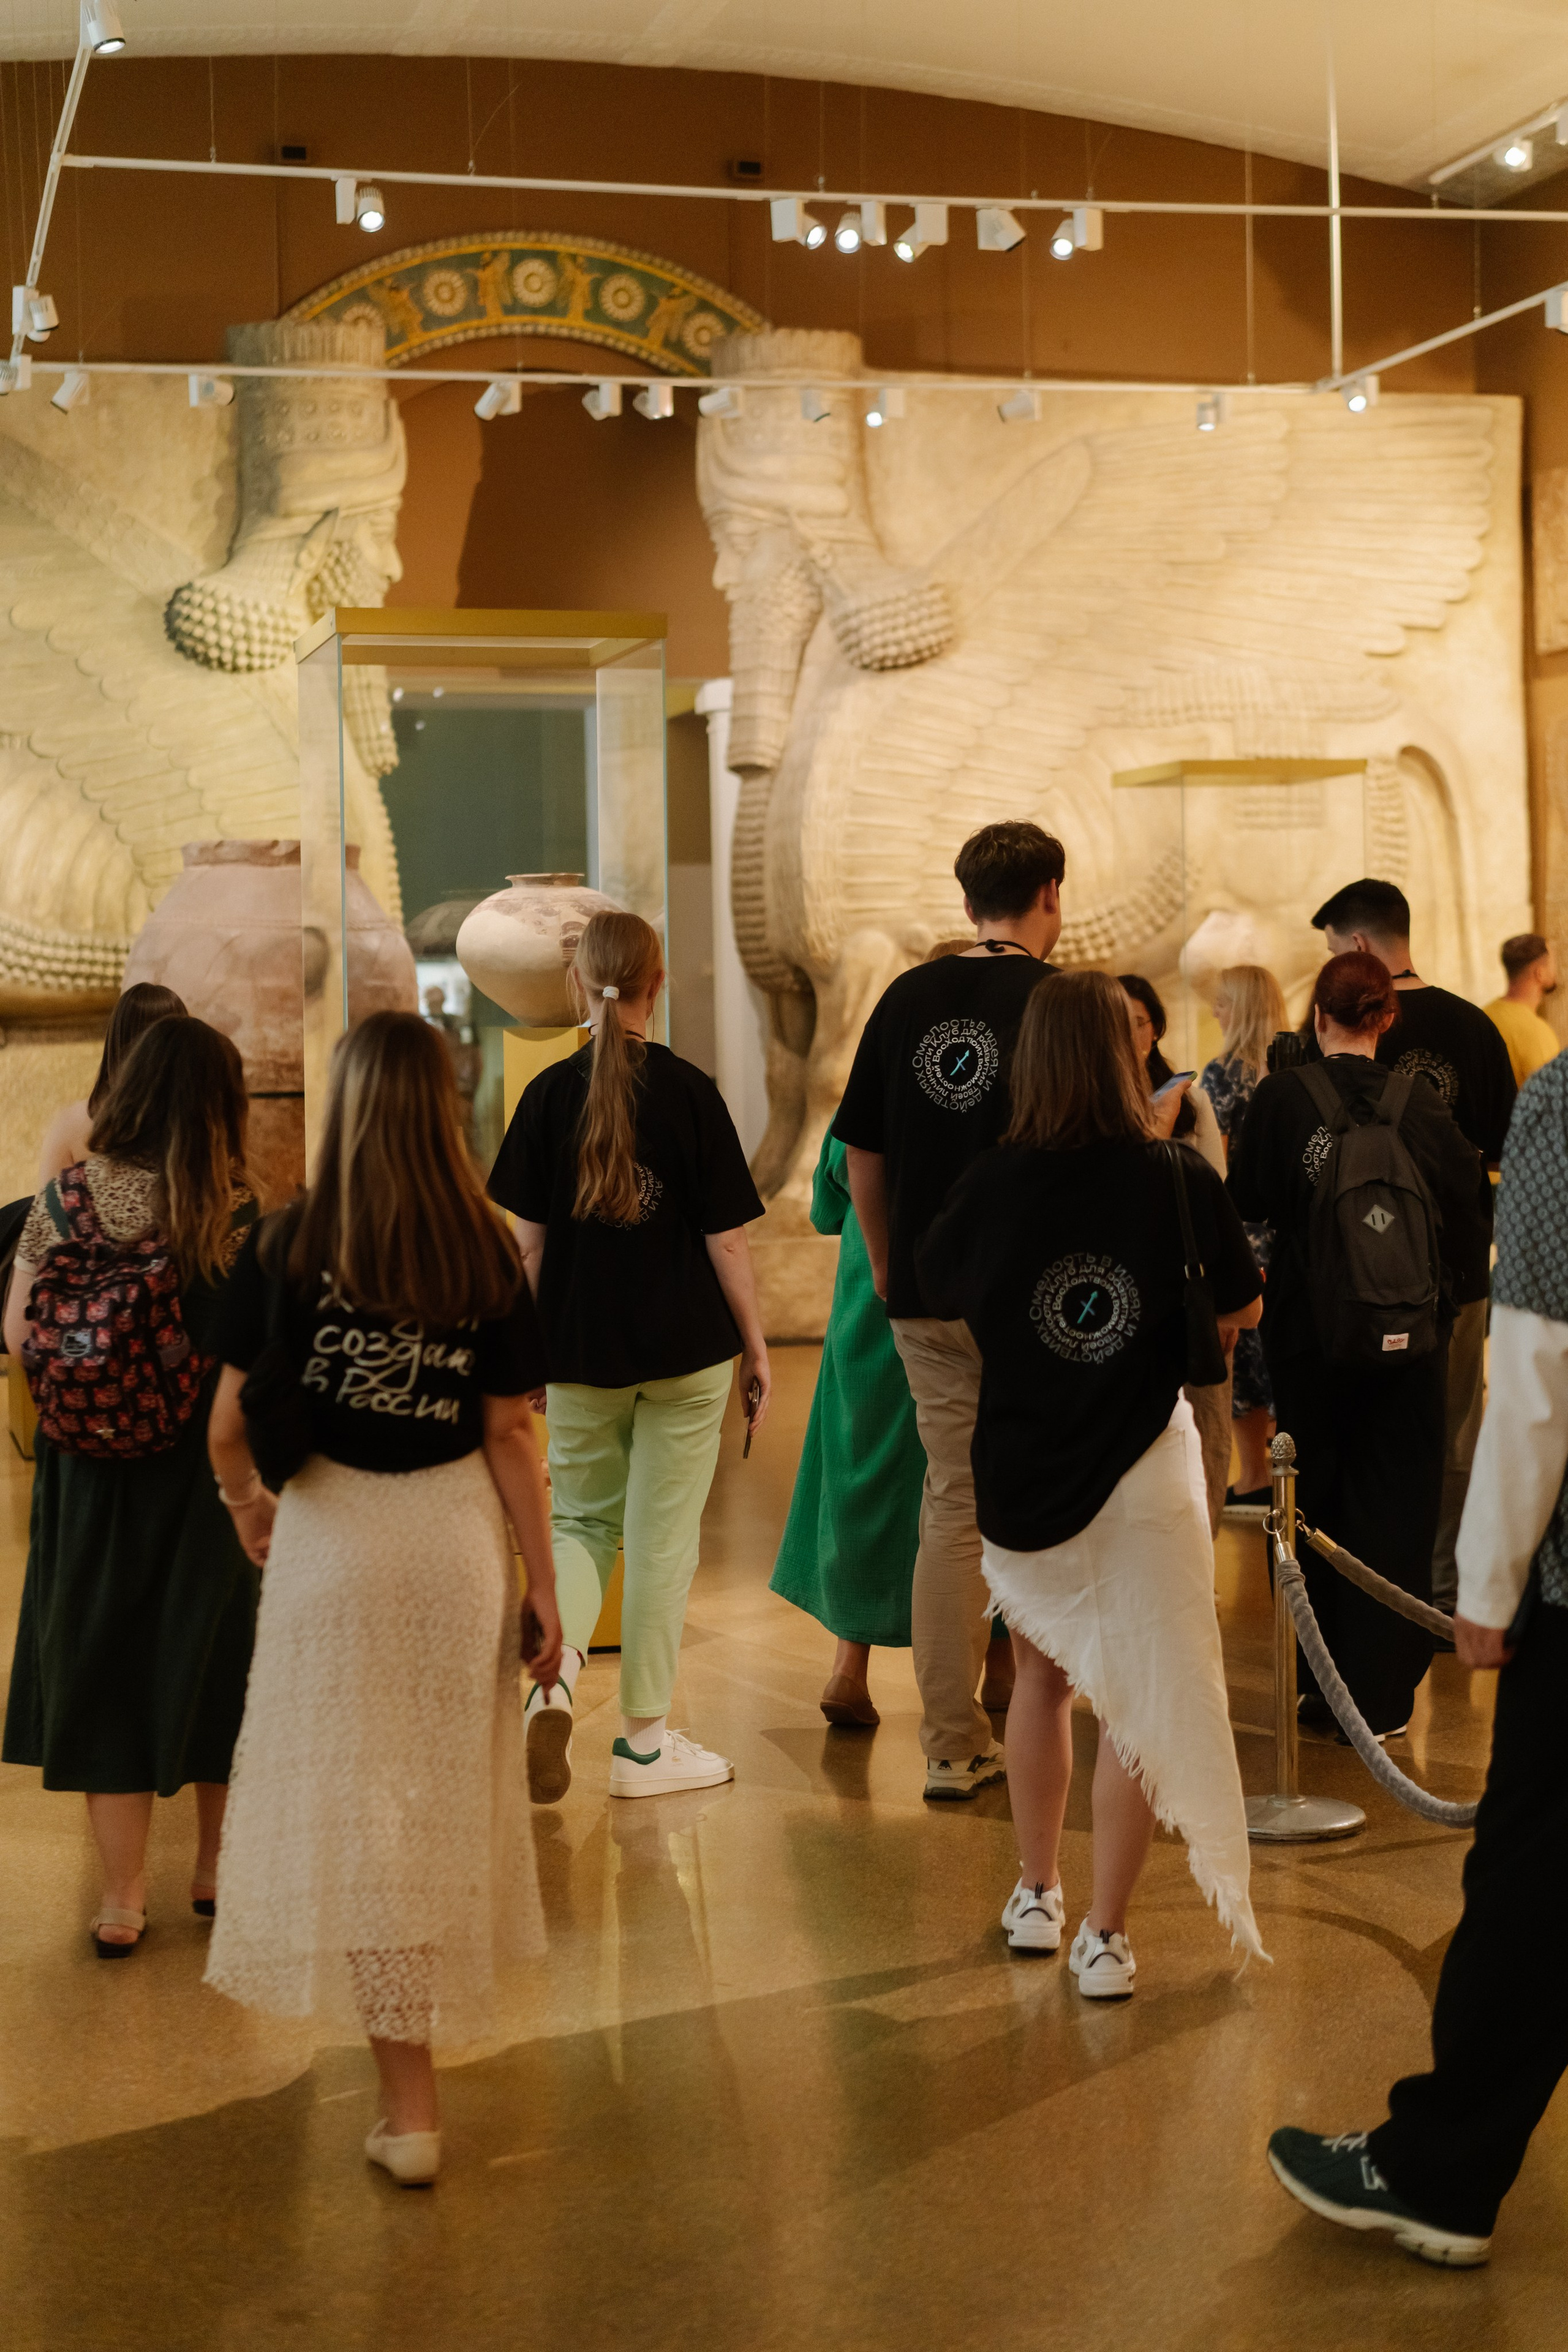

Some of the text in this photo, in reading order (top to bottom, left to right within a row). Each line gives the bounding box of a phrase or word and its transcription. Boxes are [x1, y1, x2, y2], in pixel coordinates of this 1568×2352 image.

[913, 1019, 975, 1068] Смелость
[930, 1027, 959, 1047] Клуб
[961, 1028, 978, 1037] для
[985, 1028, 998, 1077] идеях
[983, 1080, 992, 1091] и
[1029, 1253, 1096, 1321] Смелость
[1046, 1265, 1076, 1294] Клуб
[1079, 1264, 1105, 1275] для
[1114, 1264, 1141, 1321] идеях
[1123, 1323, 1137, 1338] и
